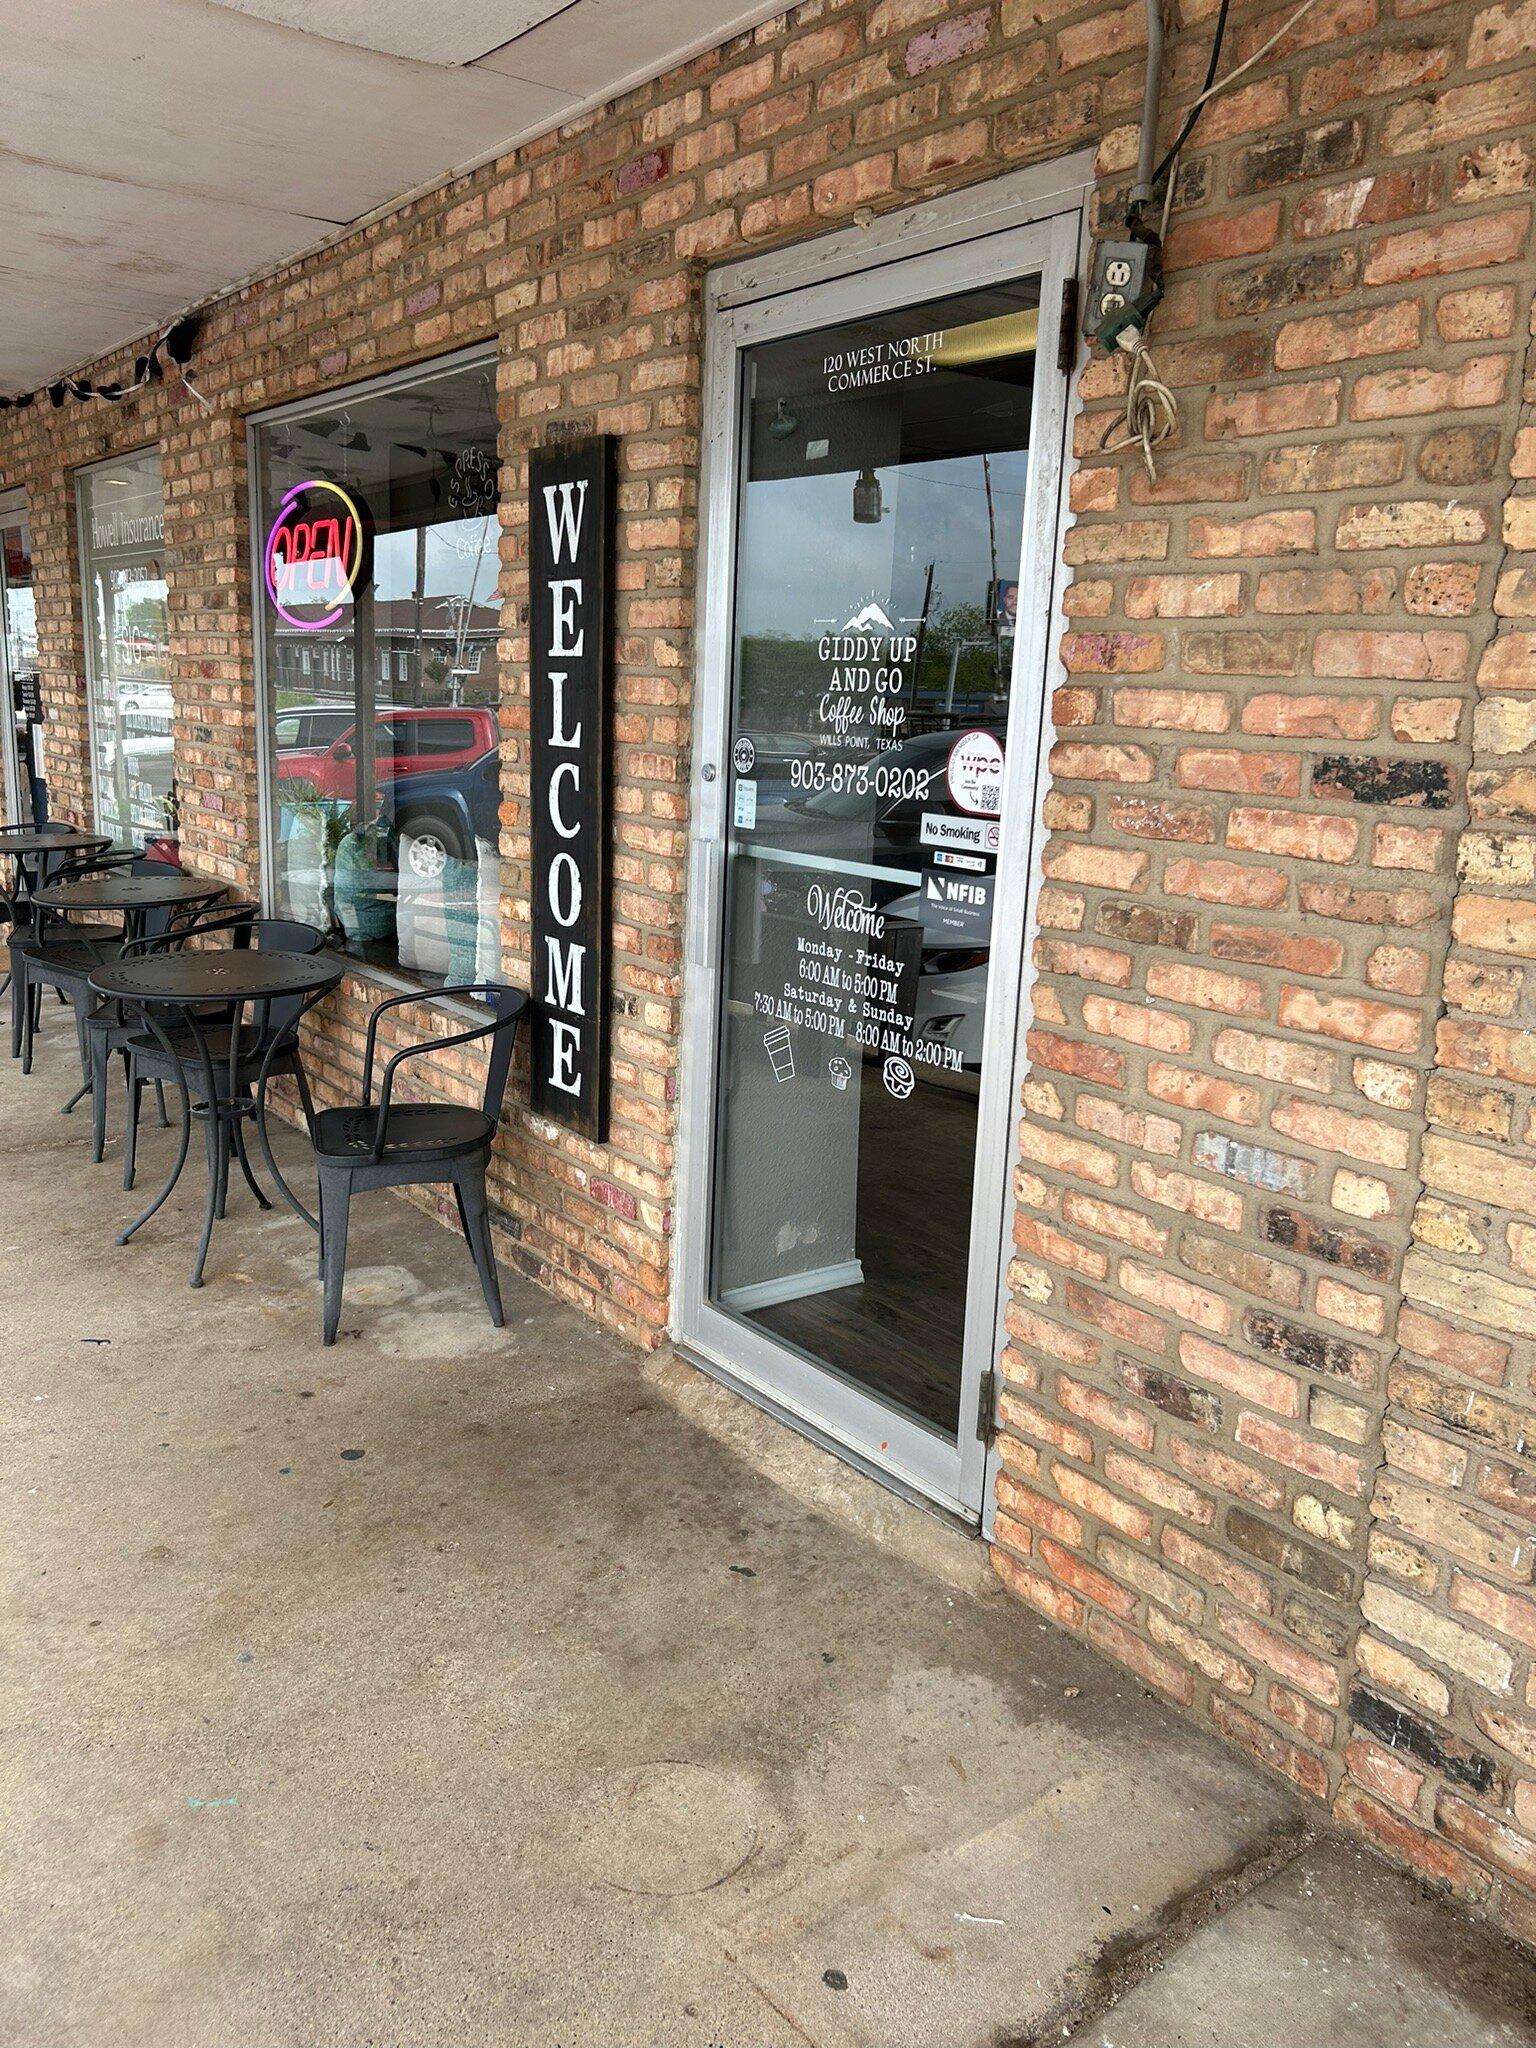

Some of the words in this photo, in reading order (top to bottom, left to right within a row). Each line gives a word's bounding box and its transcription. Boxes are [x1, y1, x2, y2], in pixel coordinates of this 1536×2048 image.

[823, 354, 843, 374] 120
[847, 344, 885, 368] WEST
[888, 331, 943, 360] NORTH
[828, 359, 912, 393] COMMERCE
[916, 354, 937, 375] ST.
[91, 512, 119, 550] Howell
[120, 511, 165, 545] Insurance
[270, 515, 353, 592] OPEN
[818, 636, 883, 661] GIDDY
[889, 636, 917, 663] UP
[828, 667, 870, 692] AND
[875, 667, 903, 694] GO
[819, 693, 864, 735] Coffee
[869, 695, 907, 738] Shop
[819, 734, 842, 747] WILLS
[844, 736, 870, 750] POINT,
[875, 738, 904, 752] TEXAS
[542, 478, 588, 1097] WELCOME
[790, 759, 930, 801] 903-873-0202
[925, 822, 939, 836] No
[939, 824, 981, 844] Smoking
[807, 884, 885, 940] Welcome
[946, 882, 987, 906] NFIB
[797, 937, 843, 963] Monday
[856, 949, 905, 978] Friday
[799, 957, 821, 983] 6:00
[821, 964, 841, 988] AM
[841, 970, 853, 991] to
[854, 973, 878, 999] 5:00
[878, 980, 899, 1005] PM
[754, 991, 775, 1016] 7:30
[775, 998, 793, 1022] AM
[793, 1004, 804, 1025] to
[804, 1007, 827, 1033] 5:00
[827, 1014, 846, 1039] PM
[783, 982, 843, 1013] Saturday
[848, 998, 858, 1014] &
[862, 1001, 914, 1032] Sunday
[855, 1021, 880, 1047] 8:00
[880, 1029, 902, 1055] AM
[902, 1035, 914, 1058] to
[915, 1038, 942, 1067] 2:00
[942, 1046, 964, 1073] PM
